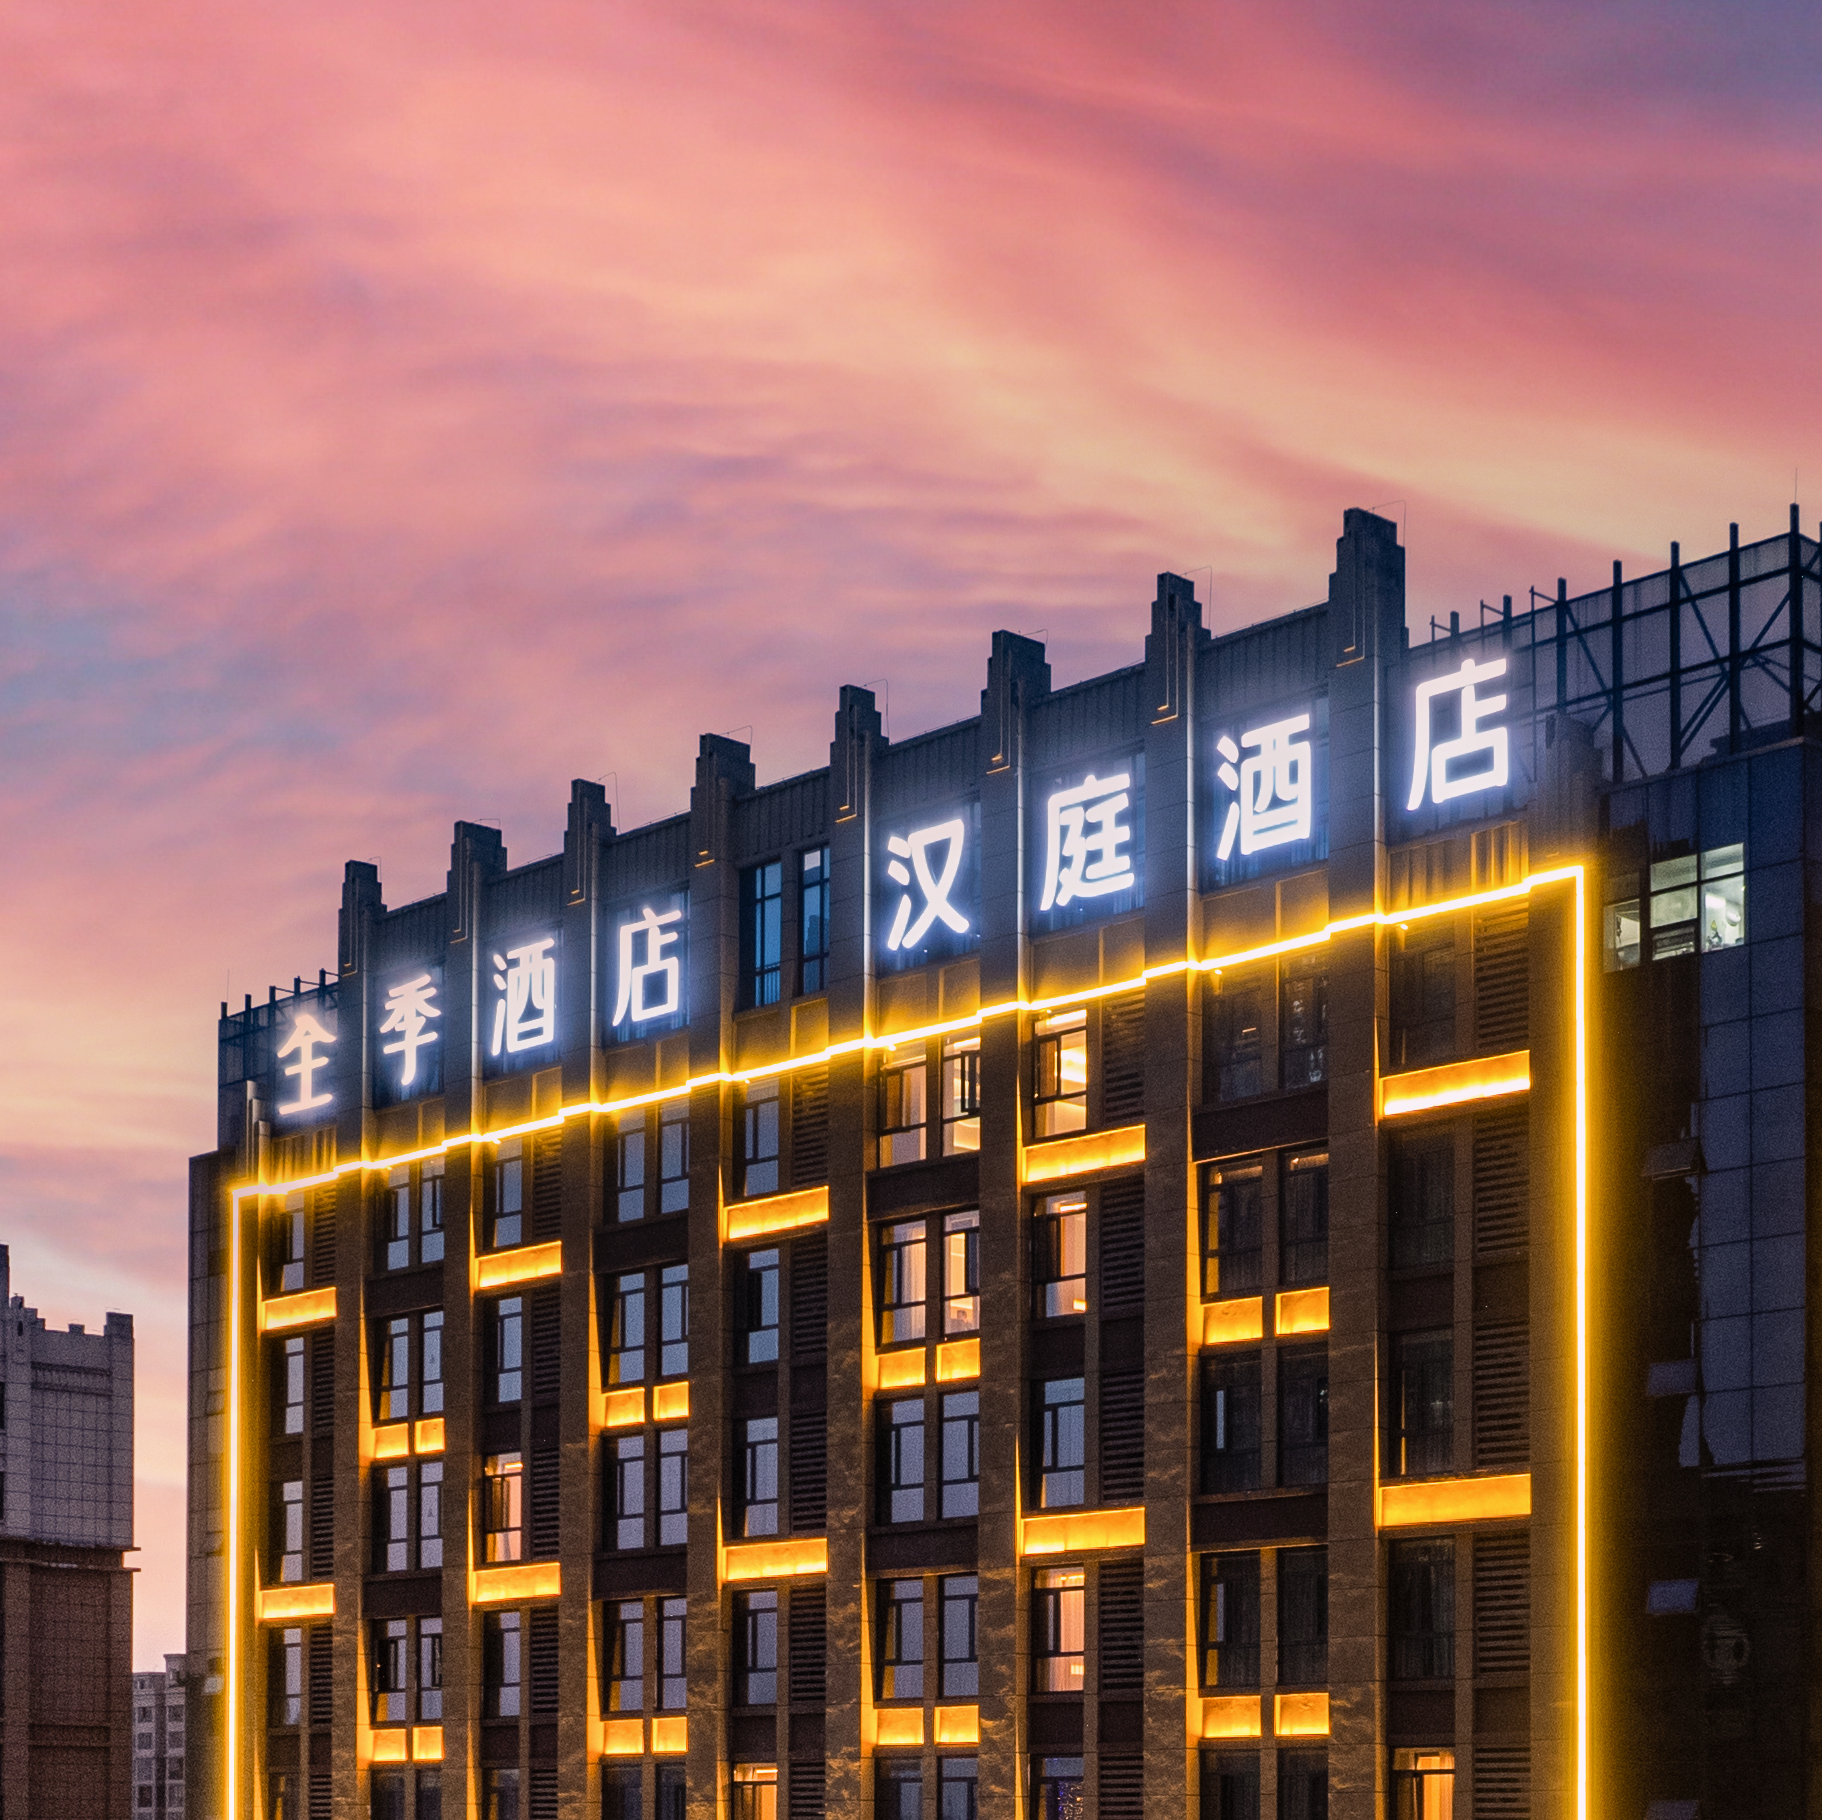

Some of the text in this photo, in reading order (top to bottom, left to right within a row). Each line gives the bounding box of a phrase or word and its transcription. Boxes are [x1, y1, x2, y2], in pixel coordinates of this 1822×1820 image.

[886, 657, 1512, 952] 汉庭酒店
[275, 906, 683, 1115] 全季酒店
